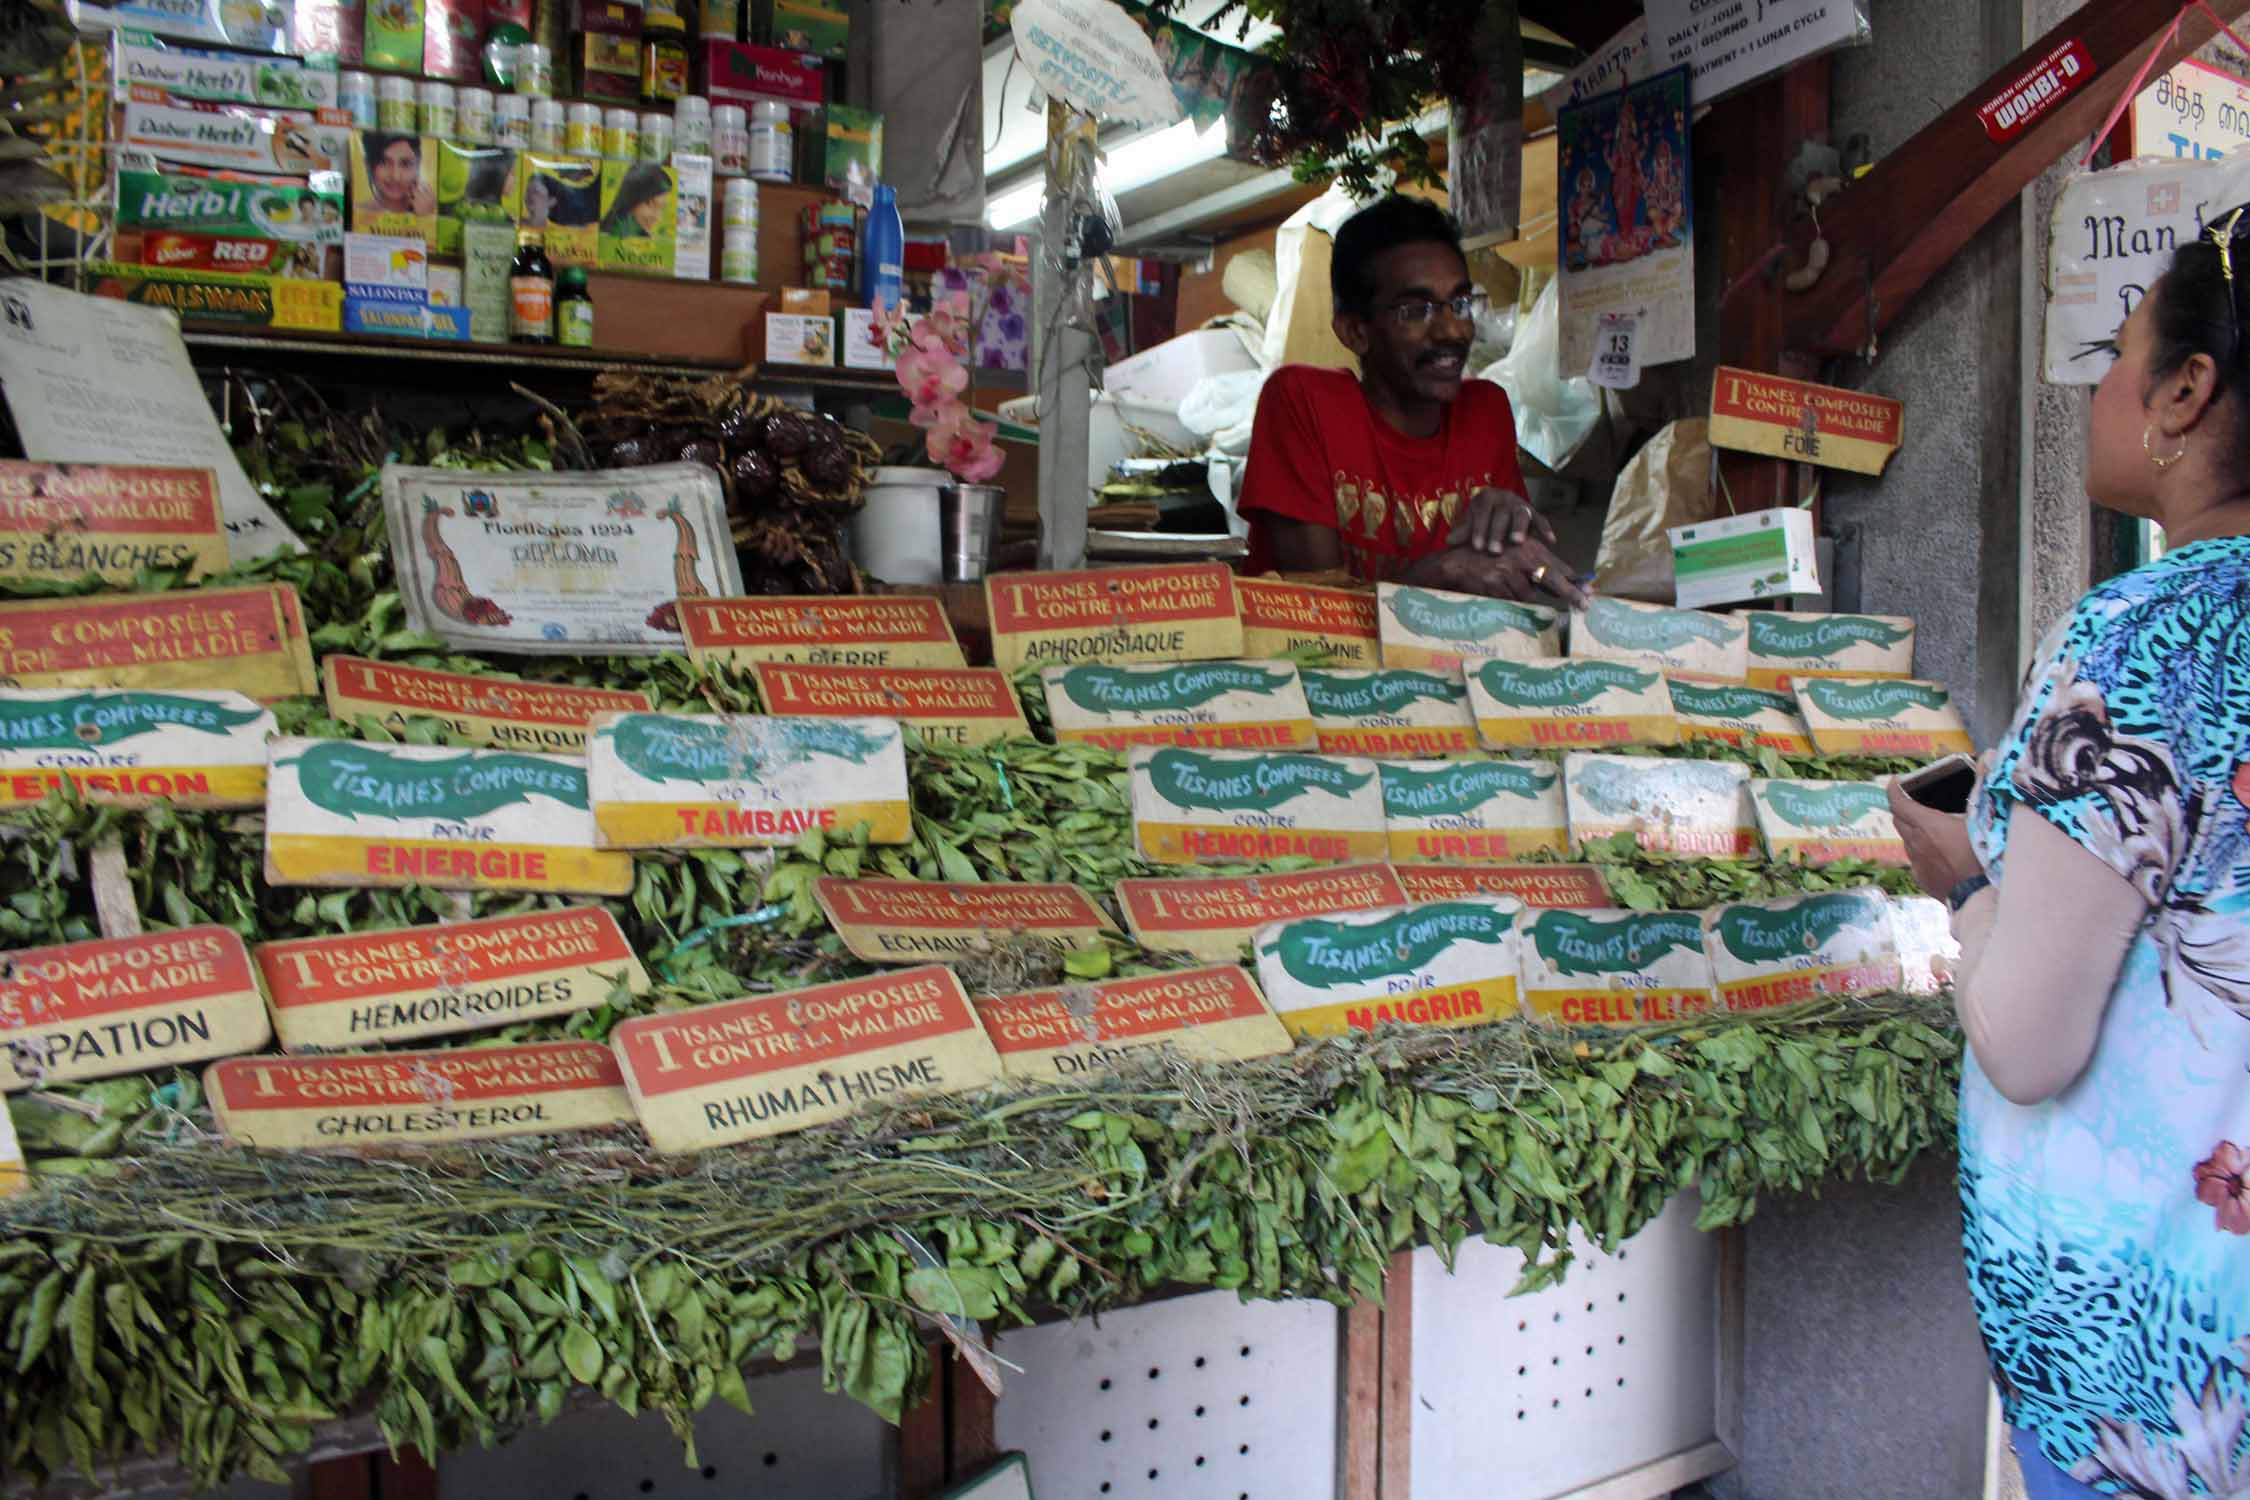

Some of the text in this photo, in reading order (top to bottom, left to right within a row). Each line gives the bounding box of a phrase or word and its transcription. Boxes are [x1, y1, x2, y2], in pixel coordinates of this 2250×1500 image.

[1667, 24, 1700, 47] DAILY
[1710, 4, 1744, 26] JOUR
[1669, 18, 1749, 63] TAG GIORNO
[1756, 27, 1792, 51] LUNAR
[1793, 8, 1828, 32] CYCLE
[1982, 40, 2073, 114] KOREAN GINSENG DRINK
[1994, 54, 2080, 129] WONBI-D
[212, 240, 268, 262] RED
[614, 241, 663, 267] Neem
[2083, 215, 2177, 261] Man
[143, 282, 268, 314] MISWAK
[1611, 335, 1630, 352] 13
[1724, 375, 1892, 419] TISANES COMPOSEES
[1825, 413, 1885, 433] MALADIE
[1783, 434, 1821, 458] FOIE
[48, 479, 202, 498] COMPOSEES
[92, 501, 194, 521] MALADIE
[591, 523, 635, 537] 1994
[26, 542, 191, 570] BLANCHES
[1002, 581, 1098, 618] TISANES
[1036, 598, 1111, 619] CONTRE
[1139, 589, 1217, 613] MALADIE
[1255, 604, 1315, 622] CONTRE
[1339, 612, 1376, 627] MALA
[1309, 594, 1376, 615] COMPOS
[1407, 599, 1465, 632] TISANES
[695, 604, 929, 636] TISANES COMPOSEES
[735, 621, 820, 637] CONTRE
[847, 619, 928, 635] MALADIE
[1753, 621, 1814, 650] TISANES
[130, 630, 259, 664] MALADIE
[808, 650, 890, 667] PIERRE
[1024, 630, 1185, 662] APHRODISIAQUE
[1286, 636, 1364, 661] INSOMNIE
[350, 664, 636, 712] TISANES COMPOSEES
[768, 669, 998, 702] TISANES COMPOSEES
[808, 691, 890, 709] CONTRE
[915, 692, 997, 709] MALADIE
[1086, 670, 1265, 704] TISANES COMPOSEES
[1304, 679, 1448, 710] TISANES COMPOSEES
[1496, 668, 1636, 700] TISANES COMPOSEES
[1818, 686, 1875, 713] TISANES
[72, 702, 217, 728] COMPOSEES
[530, 702, 593, 721] MALA
[491, 725, 588, 748] URIQU
[1318, 730, 1468, 754] COLIBACILLE
[1530, 720, 1634, 743] ULCERE
[330, 758, 578, 806] TISANES COMPOSEES
[1171, 761, 1344, 800] TISANES COMPOSEES
[1381, 770, 1530, 810] TISANES COMPOSEES
[432, 822, 497, 841] POUR
[1233, 814, 1296, 829] CONTRE
[1416, 834, 1511, 858] UREE
[365, 845, 548, 880] ENERGIE
[1136, 871, 1386, 919] TISANES COMPOSEES
[1473, 873, 1590, 891] COMPOSEES
[832, 883, 1074, 914] TISANES COMPOSEES
[878, 903, 964, 921] CONTRE
[991, 903, 1074, 922] MALADIE
[1180, 904, 1266, 922] CONTRE
[1298, 887, 1386, 915] MALADIE
[277, 915, 600, 990] TISANES COMPOSEES
[1300, 914, 1494, 975] TISANES COMPOSEES
[1552, 920, 1702, 962] TISANES COMPOSEES
[13, 935, 224, 987] COMPOSEES
[332, 959, 443, 989] CONTRE
[487, 934, 599, 969] MALADIE
[76, 960, 217, 1003] MALADIE
[1386, 974, 1436, 996] POUR
[1724, 975, 1816, 1011] FAIBLESSE
[350, 976, 573, 1034] HEMORROIDES
[1135, 991, 1235, 1023] MALADIE
[1346, 988, 1485, 1033] MAIGRIR
[635, 977, 945, 1074] TISANES COMPOSEES
[692, 1003, 945, 1070] CONTRE LA MALADIE
[237, 1063, 401, 1098] TISANES
[475, 1064, 600, 1090] MALADIE
[702, 1055, 944, 1131] RHUMATHISME
[316, 1102, 553, 1137] CHOLESTEROL
